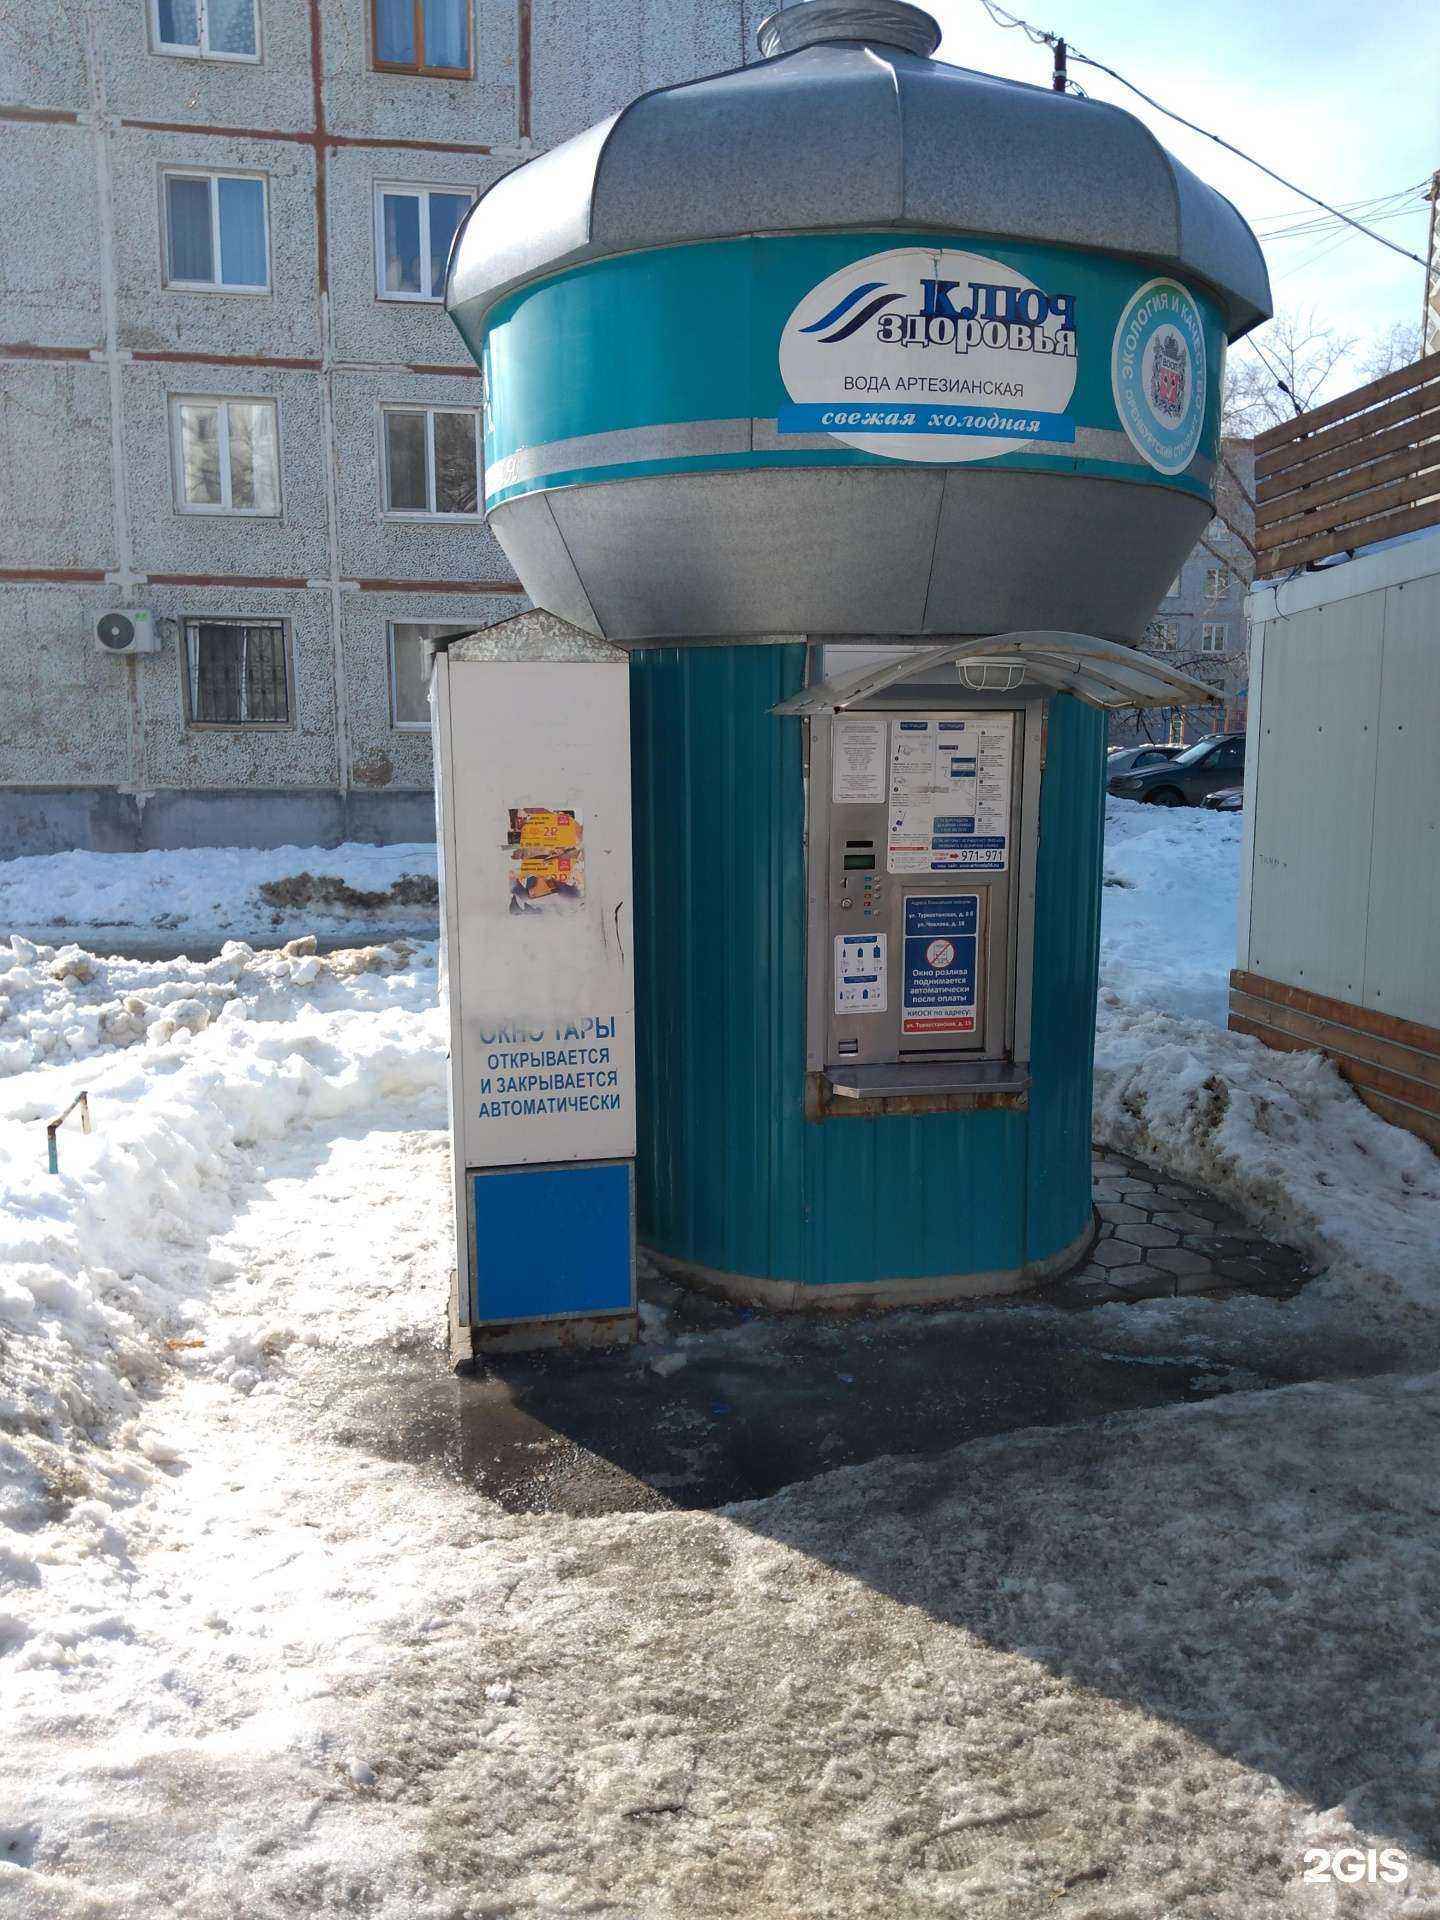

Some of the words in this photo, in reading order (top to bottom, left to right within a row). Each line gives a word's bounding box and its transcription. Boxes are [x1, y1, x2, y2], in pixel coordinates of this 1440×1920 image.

[1121, 292, 1169, 380] ЭКОЛОГИЯ
[1171, 295, 1179, 311] И
[843, 375, 891, 393] ВОДА
[894, 376, 1024, 398] АРТЕЗИАНСКАЯ
[820, 409, 918, 427] свежая
[927, 411, 1041, 433] холодная
[961, 850, 1003, 861] 971-971
[912, 969, 934, 977] Окно
[935, 969, 968, 978] розлива
[913, 978, 967, 986] поднимается
[910, 986, 970, 994] автоматически
[937, 995, 967, 1003] оплаты
[487, 1047, 610, 1070] ОТКРЫВАЕТСЯ
[480, 1078, 492, 1095] И
[496, 1070, 619, 1094] ЗАКРЫВАЕТСЯ
[478, 1093, 621, 1119] АВТОМАТИЧЕСКИ
